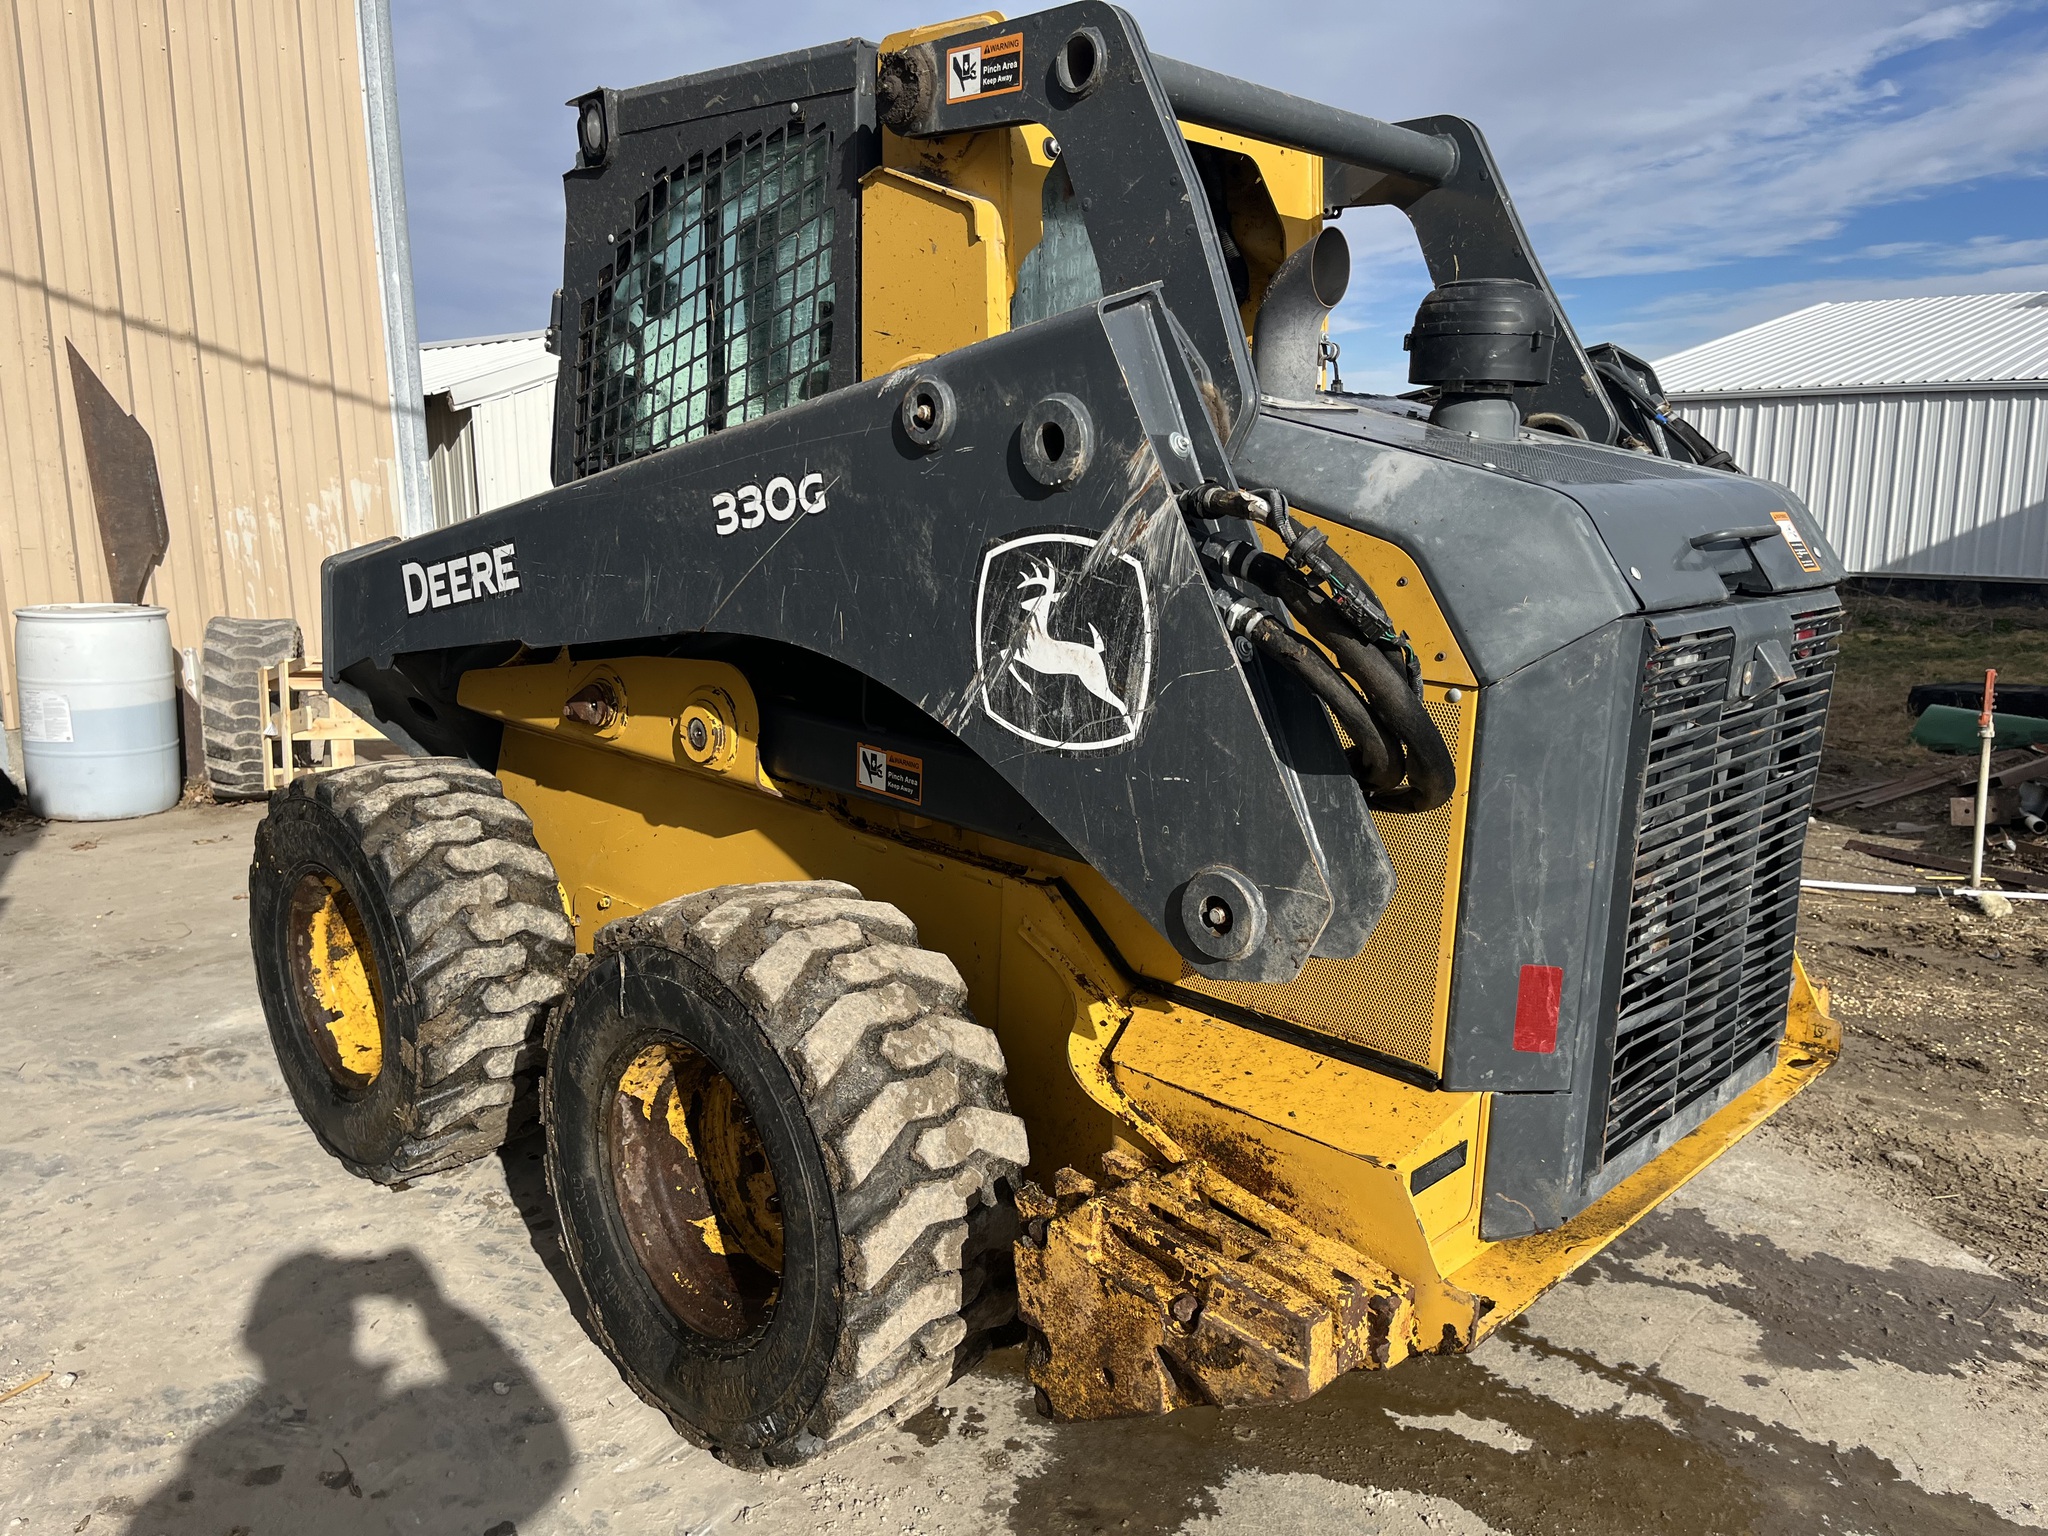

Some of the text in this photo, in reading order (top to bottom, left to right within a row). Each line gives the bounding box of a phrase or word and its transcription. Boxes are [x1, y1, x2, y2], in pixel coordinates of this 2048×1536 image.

[990, 39, 1019, 52] WARNING
[983, 60, 1018, 75] Pinch Area
[982, 74, 1013, 86] Keep Away
[712, 473, 827, 535] 330G
[402, 543, 520, 614] DEERE
[894, 758, 920, 769] WARNING
[887, 771, 918, 786] Pinch Area
[887, 781, 913, 794] Keep Away
